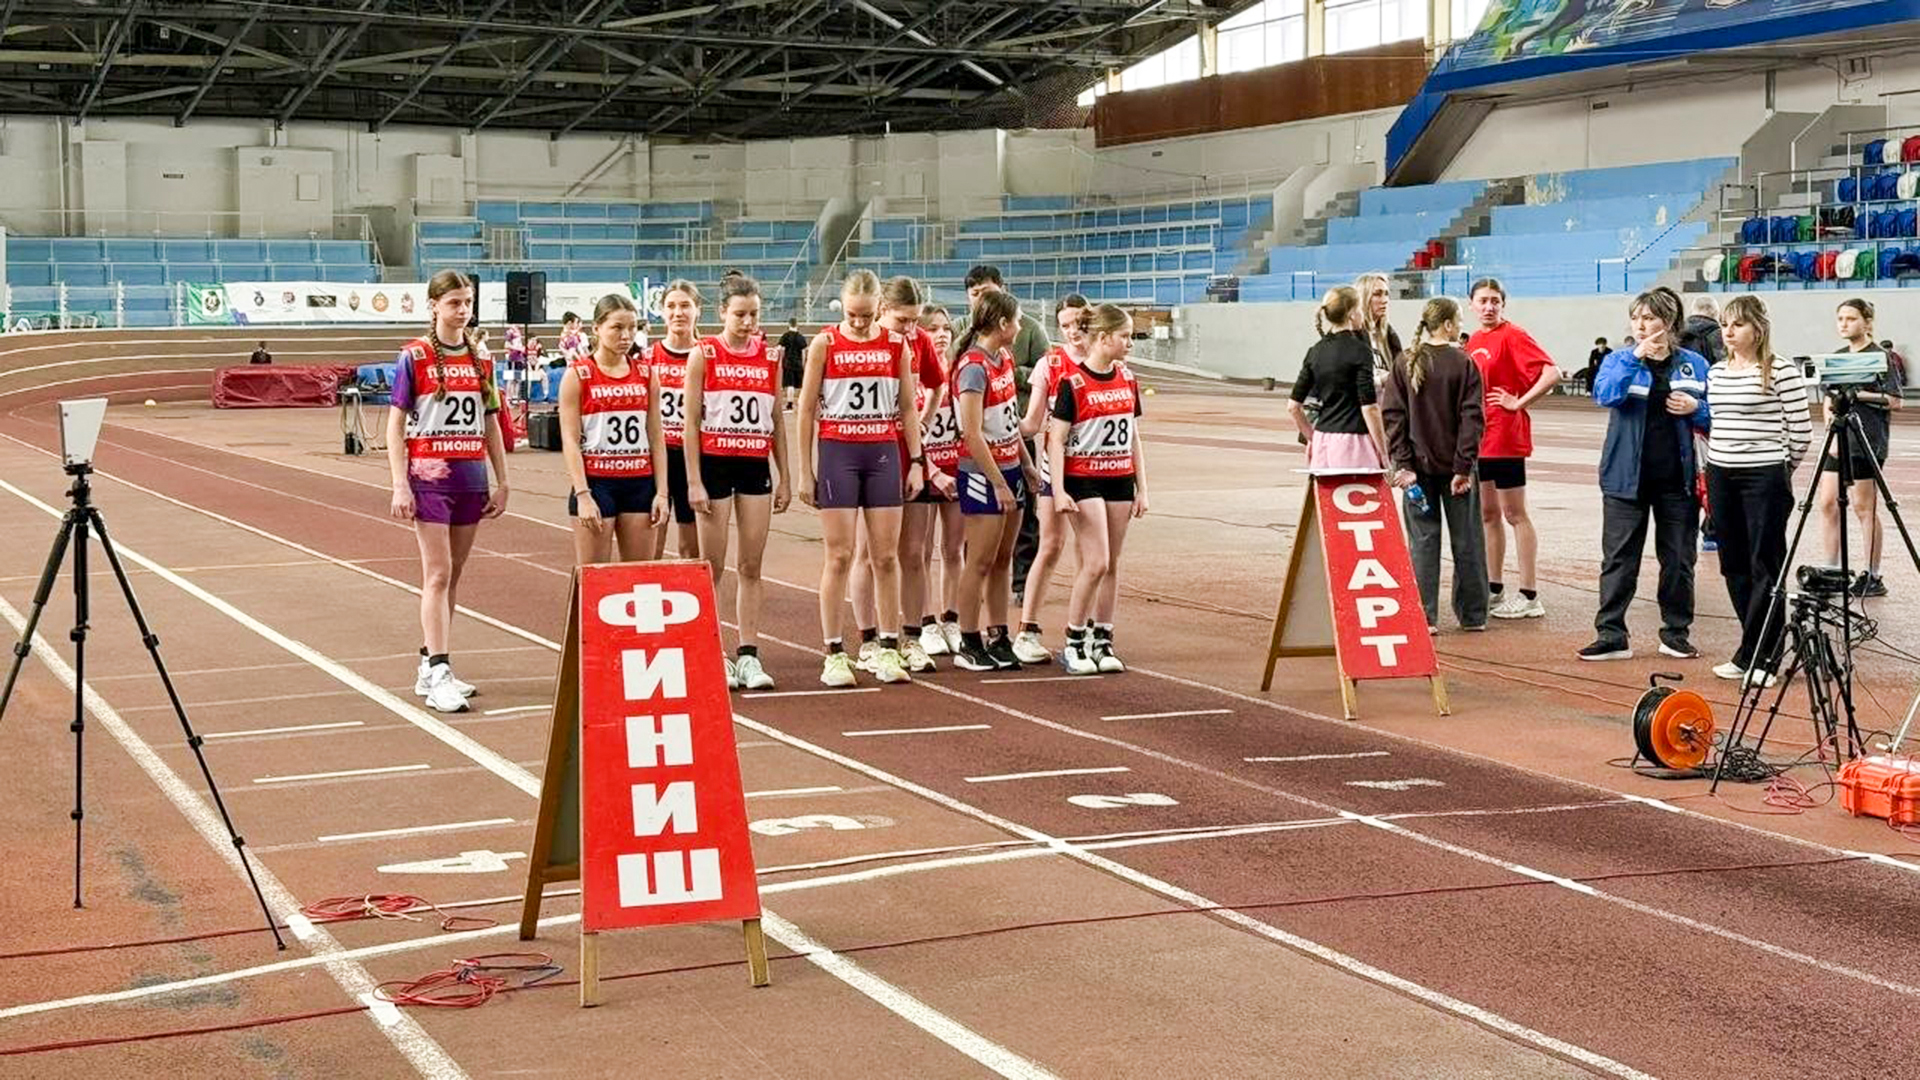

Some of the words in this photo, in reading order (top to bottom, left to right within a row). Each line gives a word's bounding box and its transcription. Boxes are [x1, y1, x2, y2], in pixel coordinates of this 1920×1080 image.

[834, 351, 892, 364] ПИОНЕР
[716, 366, 769, 380] ПИОНЕР
[590, 385, 648, 399] ПИОНЕР
[849, 382, 879, 410] 31
[444, 396, 476, 426] 29
[730, 396, 760, 424] 30
[607, 415, 640, 445] 36
[838, 424, 889, 435] ПИОНЕР
[1101, 418, 1129, 446] 28
[1332, 483, 1408, 667] СТАРТ
[598, 583, 723, 907] ФИНИШ
